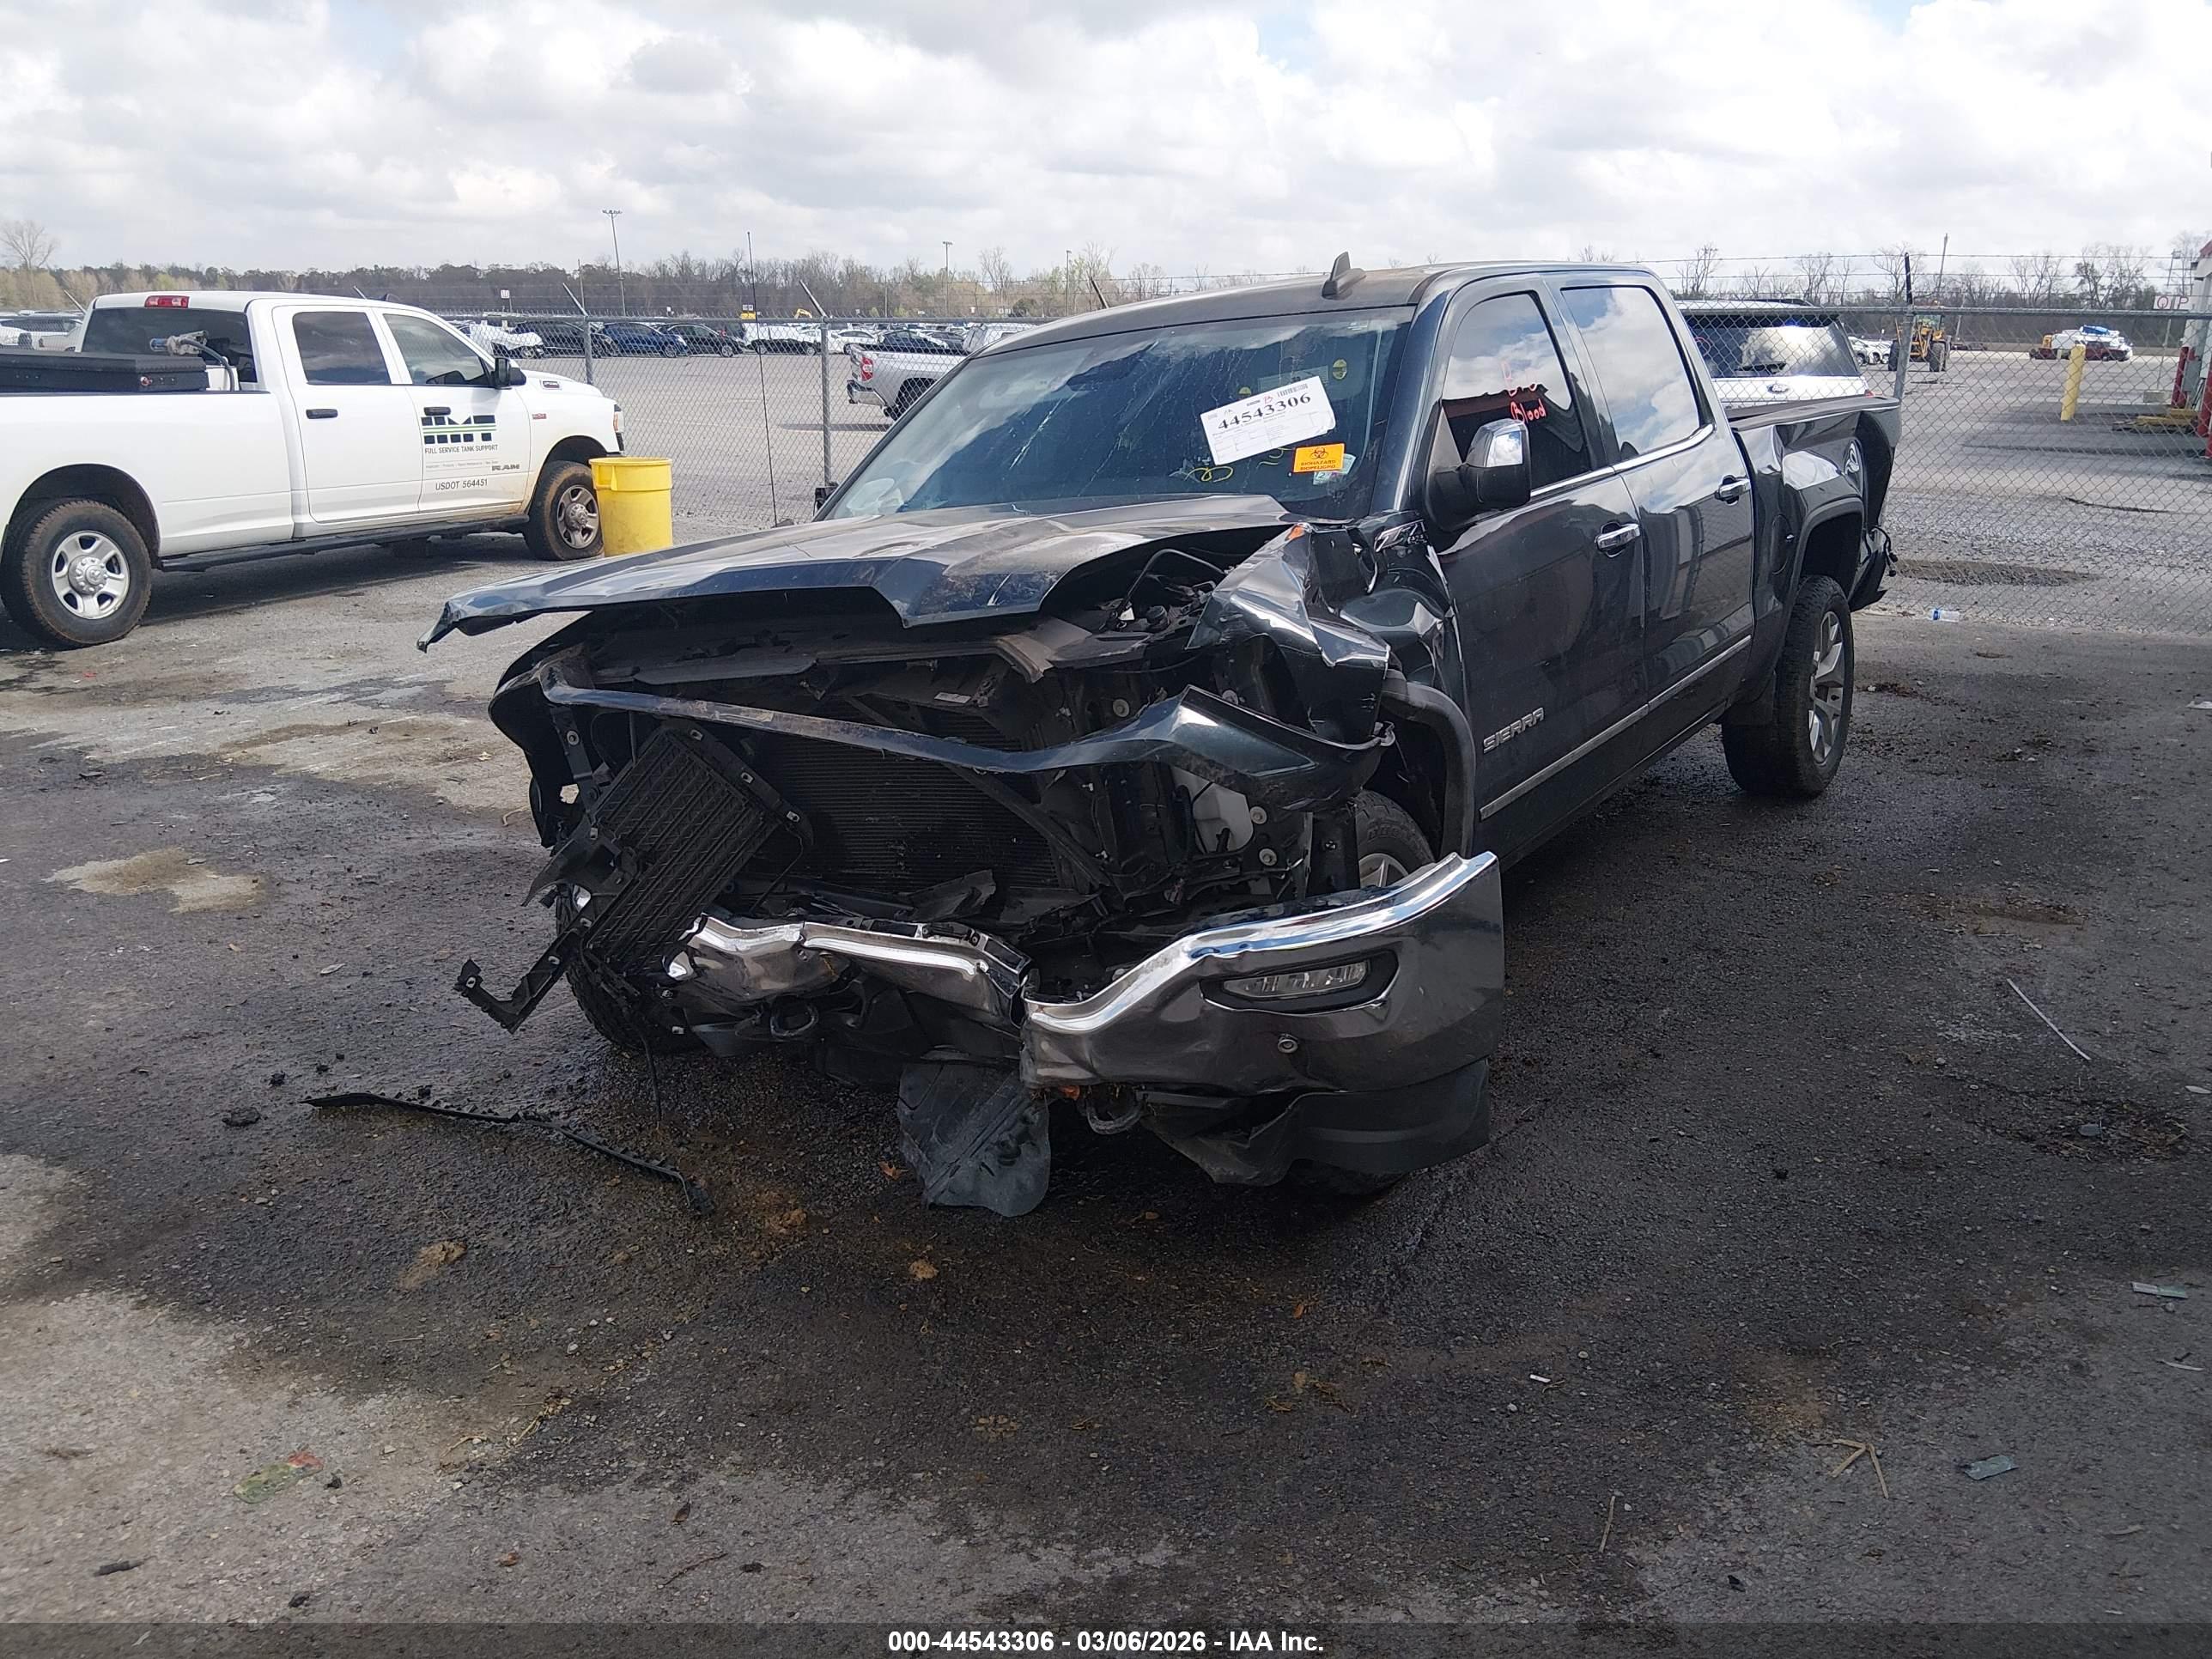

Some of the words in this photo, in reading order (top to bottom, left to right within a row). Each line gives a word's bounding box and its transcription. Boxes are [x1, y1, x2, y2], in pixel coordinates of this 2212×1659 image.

[1218, 392, 1311, 429] 44543306
[435, 481, 460, 490] USDOT
[462, 478, 488, 489] 564451
[1483, 707, 1544, 754] SIERRA
